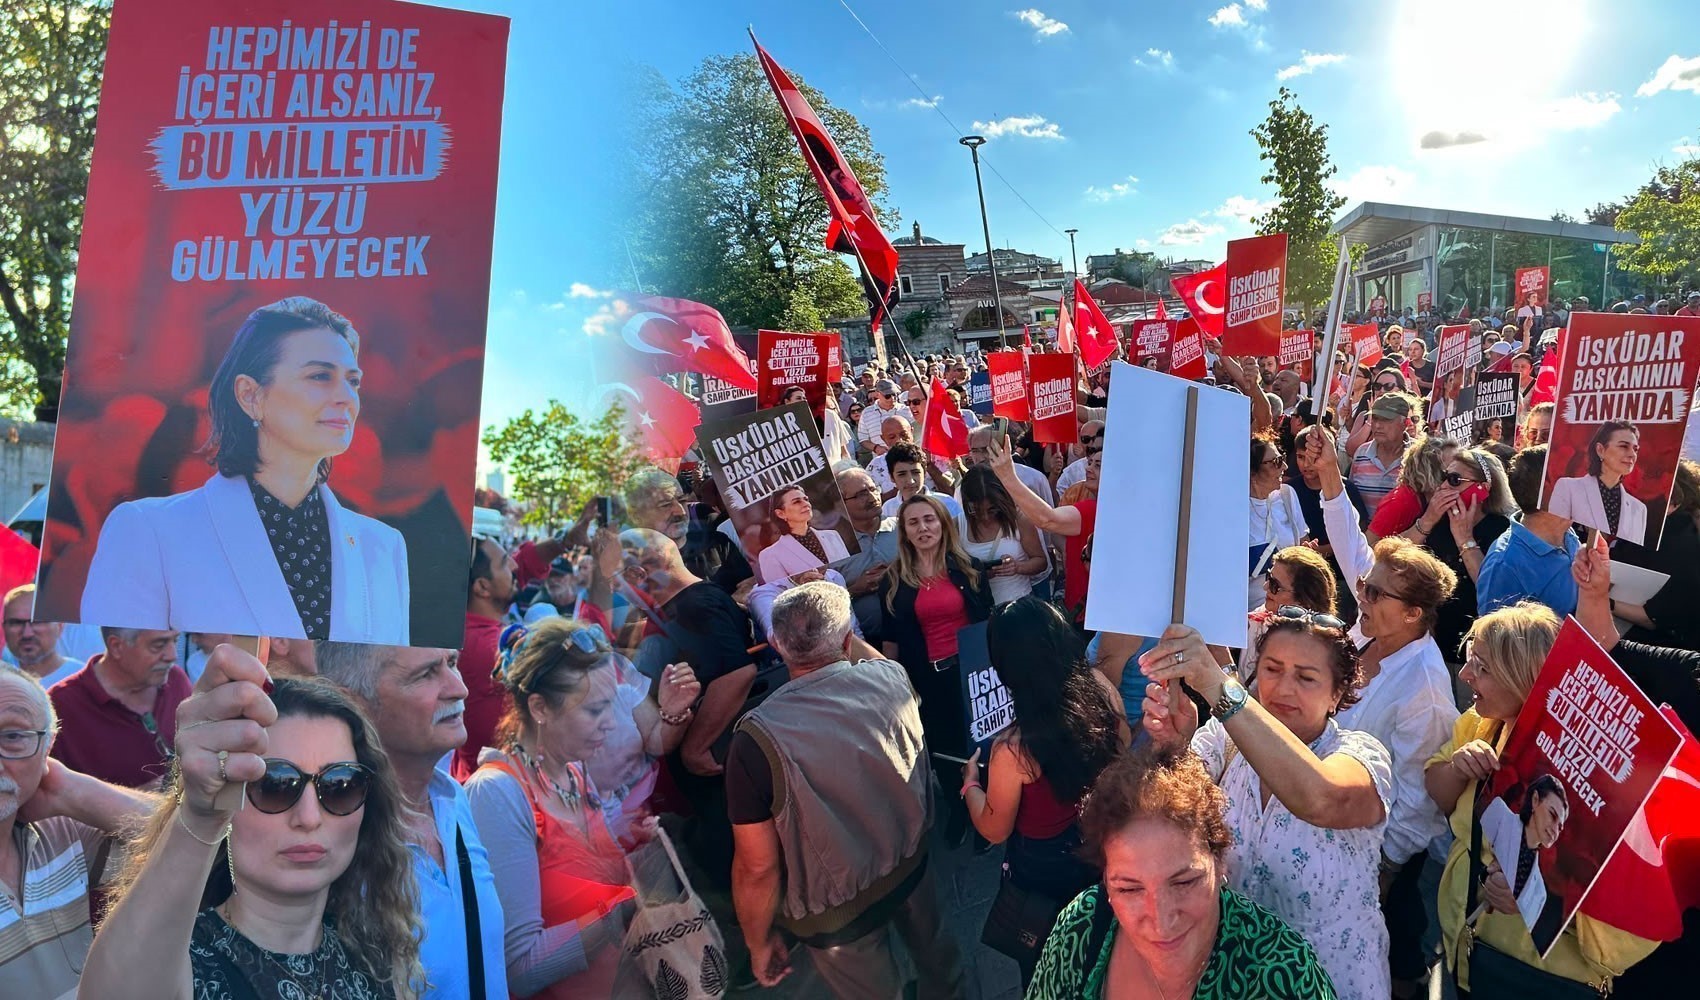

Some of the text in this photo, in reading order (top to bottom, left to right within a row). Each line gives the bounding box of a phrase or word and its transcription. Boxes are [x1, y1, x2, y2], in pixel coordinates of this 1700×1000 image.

[205, 19, 420, 71] HEPİMİZİ DE
[175, 66, 442, 127] İÇERİ ALSANIZ,
[178, 125, 427, 181] BU MİLLETİN
[239, 185, 368, 237] YÜZÜ
[171, 235, 431, 282] GÜLMEYECEK
[1230, 267, 1280, 297] ÜSKÜDAR
[1229, 285, 1279, 312] İRADESİNE
[1230, 301, 1277, 325] SAHİP ÇIKIYOR
[771, 347, 790, 358] İÇERİ
[776, 338, 805, 348] HEPİMİZİ
[1281, 350, 1310, 364] YANINDA
[1577, 330, 1685, 367] ÜSKÜDAR
[772, 359, 783, 369] BU
[784, 356, 816, 368] MİLLETİN
[783, 367, 806, 377] YÜZÜ
[1572, 362, 1685, 393] BAŞKANININ
[772, 374, 817, 386] GÜLMEYECEK
[1033, 377, 1071, 397] ÜSKÜDAR
[1477, 377, 1513, 395] ÜSKÜDAR
[707, 390, 731, 404] SAHİP
[1034, 389, 1072, 410] İRADESİNE
[1036, 405, 1053, 418] SAHİP
[1478, 403, 1512, 419] YANINDA
[1573, 391, 1673, 421] YANINDA
[712, 411, 800, 464] ÜSKÜDAR
[722, 430, 811, 484] BAŞKANININ
[733, 451, 819, 505] YANINDA
[1551, 696, 1571, 721] BU
[1574, 659, 1645, 732] HEPİMİZİ DE
[976, 708, 1006, 738] SAHİP
[1558, 669, 1641, 760] İÇERİ ALSANIZ,
[1557, 729, 1597, 779] YÜZÜ
[1535, 730, 1607, 817] GÜLMEYECEK
